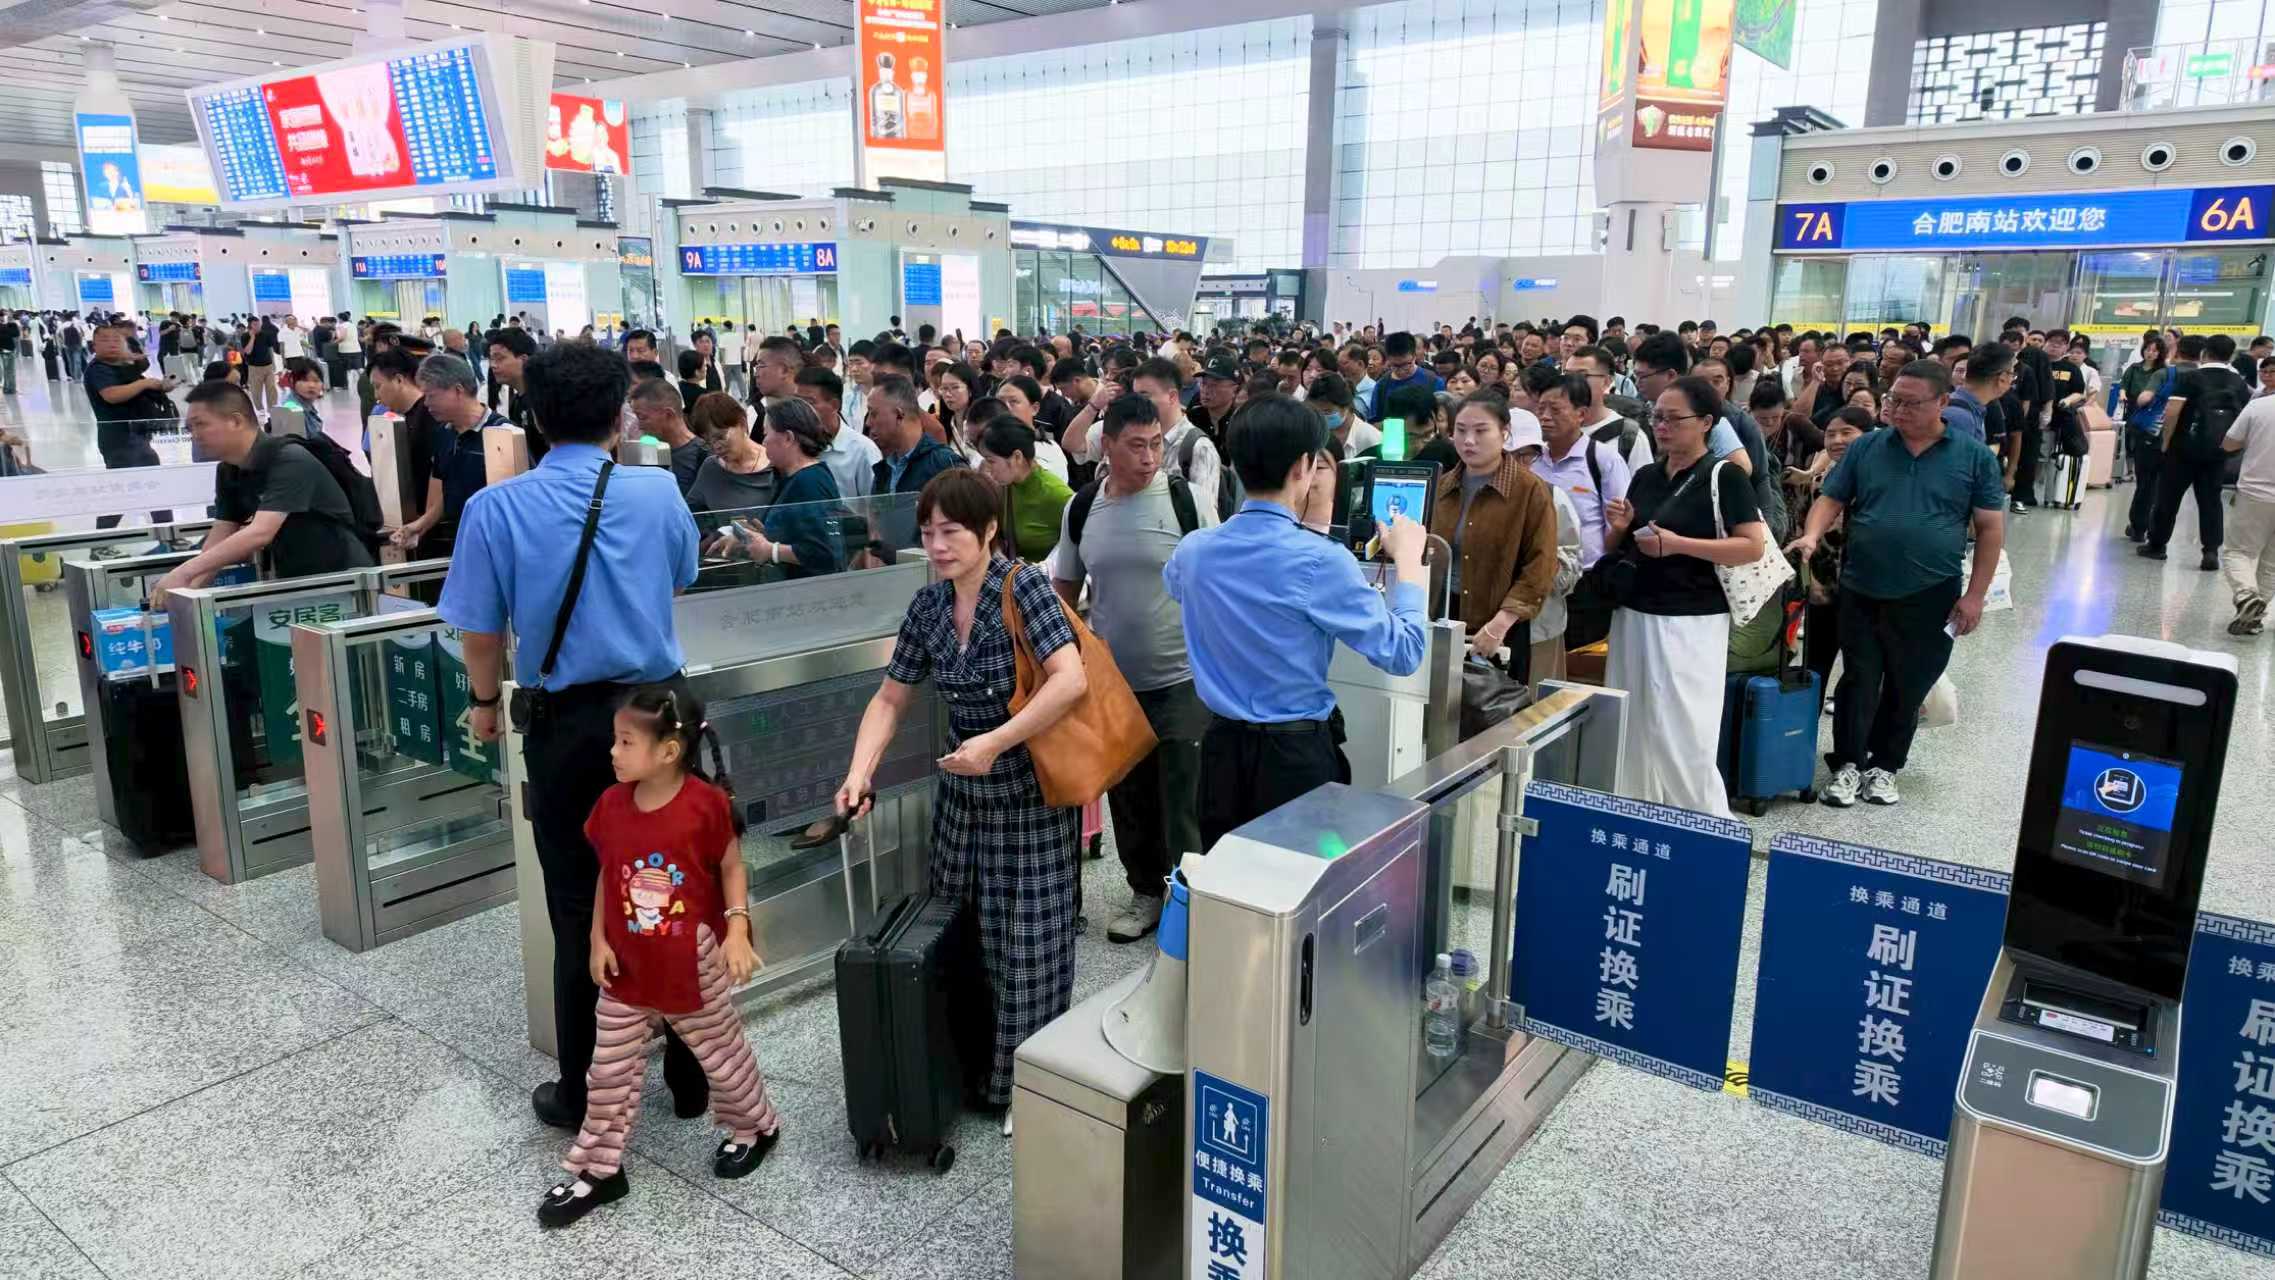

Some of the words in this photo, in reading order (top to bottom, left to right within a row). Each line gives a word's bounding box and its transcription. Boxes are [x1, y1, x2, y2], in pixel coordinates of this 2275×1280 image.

[1795, 212, 1833, 241] 7A
[1912, 207, 2107, 236] 合肥南站欢迎您
[2201, 197, 2255, 232] 6A
[686, 251, 702, 268] 9A
[816, 249, 834, 267] 8A
[268, 603, 341, 630] 安居客
[393, 653, 426, 681] 新房
[396, 686, 429, 712] 二手房
[399, 716, 432, 743] 租房
[1591, 828, 1672, 861] 换乘通道
[1850, 885, 1948, 921] 换乘通道
[1594, 863, 1648, 1031] 刷证换乘
[2228, 955, 2275, 984] 换乘
[1852, 923, 1918, 1107] 刷证换乘
[1195, 1150, 1264, 1194] 便捷换乘
[1202, 1176, 1256, 1209] Transfer
